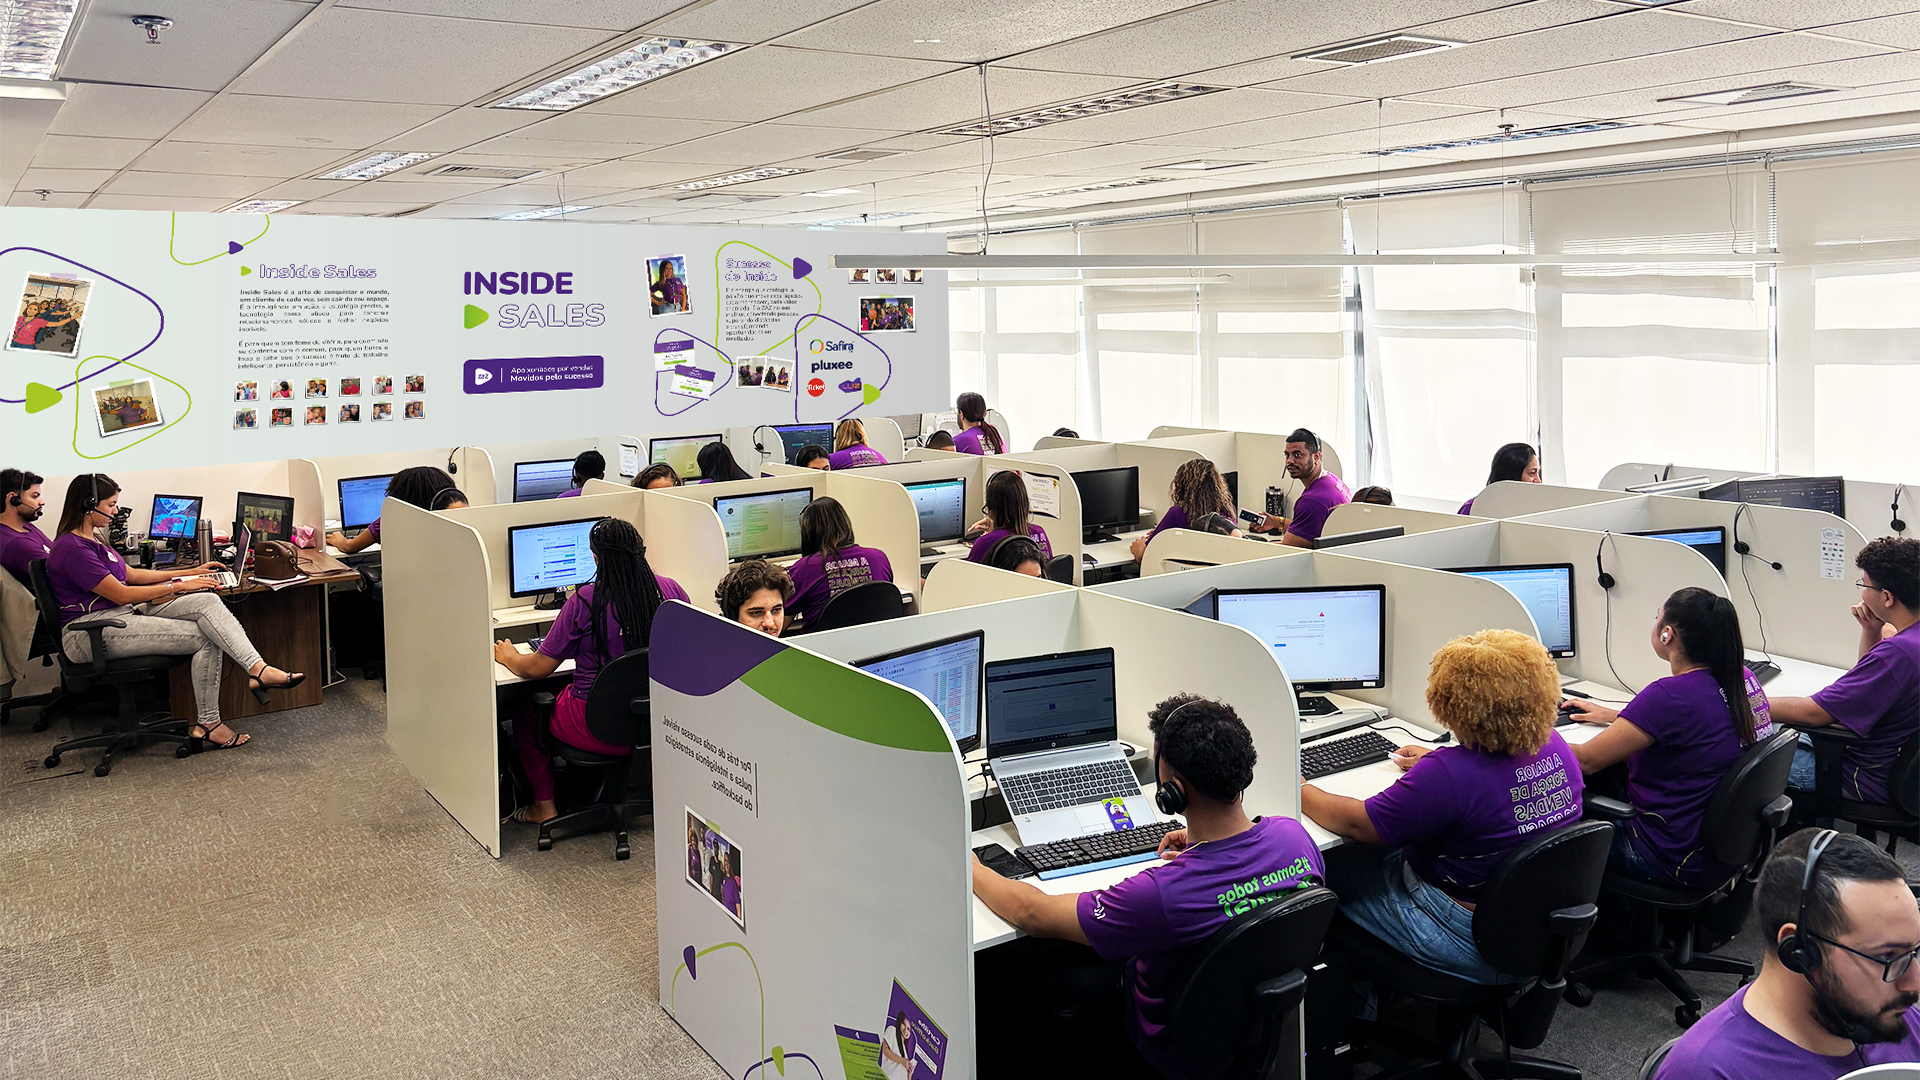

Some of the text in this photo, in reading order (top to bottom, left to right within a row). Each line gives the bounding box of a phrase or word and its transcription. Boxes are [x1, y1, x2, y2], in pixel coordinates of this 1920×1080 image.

[259, 264, 377, 279] Inside Sales
[464, 271, 573, 295] INSIDE
[499, 303, 605, 328] SALES
[825, 340, 854, 352] Safira
[811, 360, 853, 373] pluxee
[510, 374, 544, 382] Movidos
[545, 373, 562, 382] pelo
